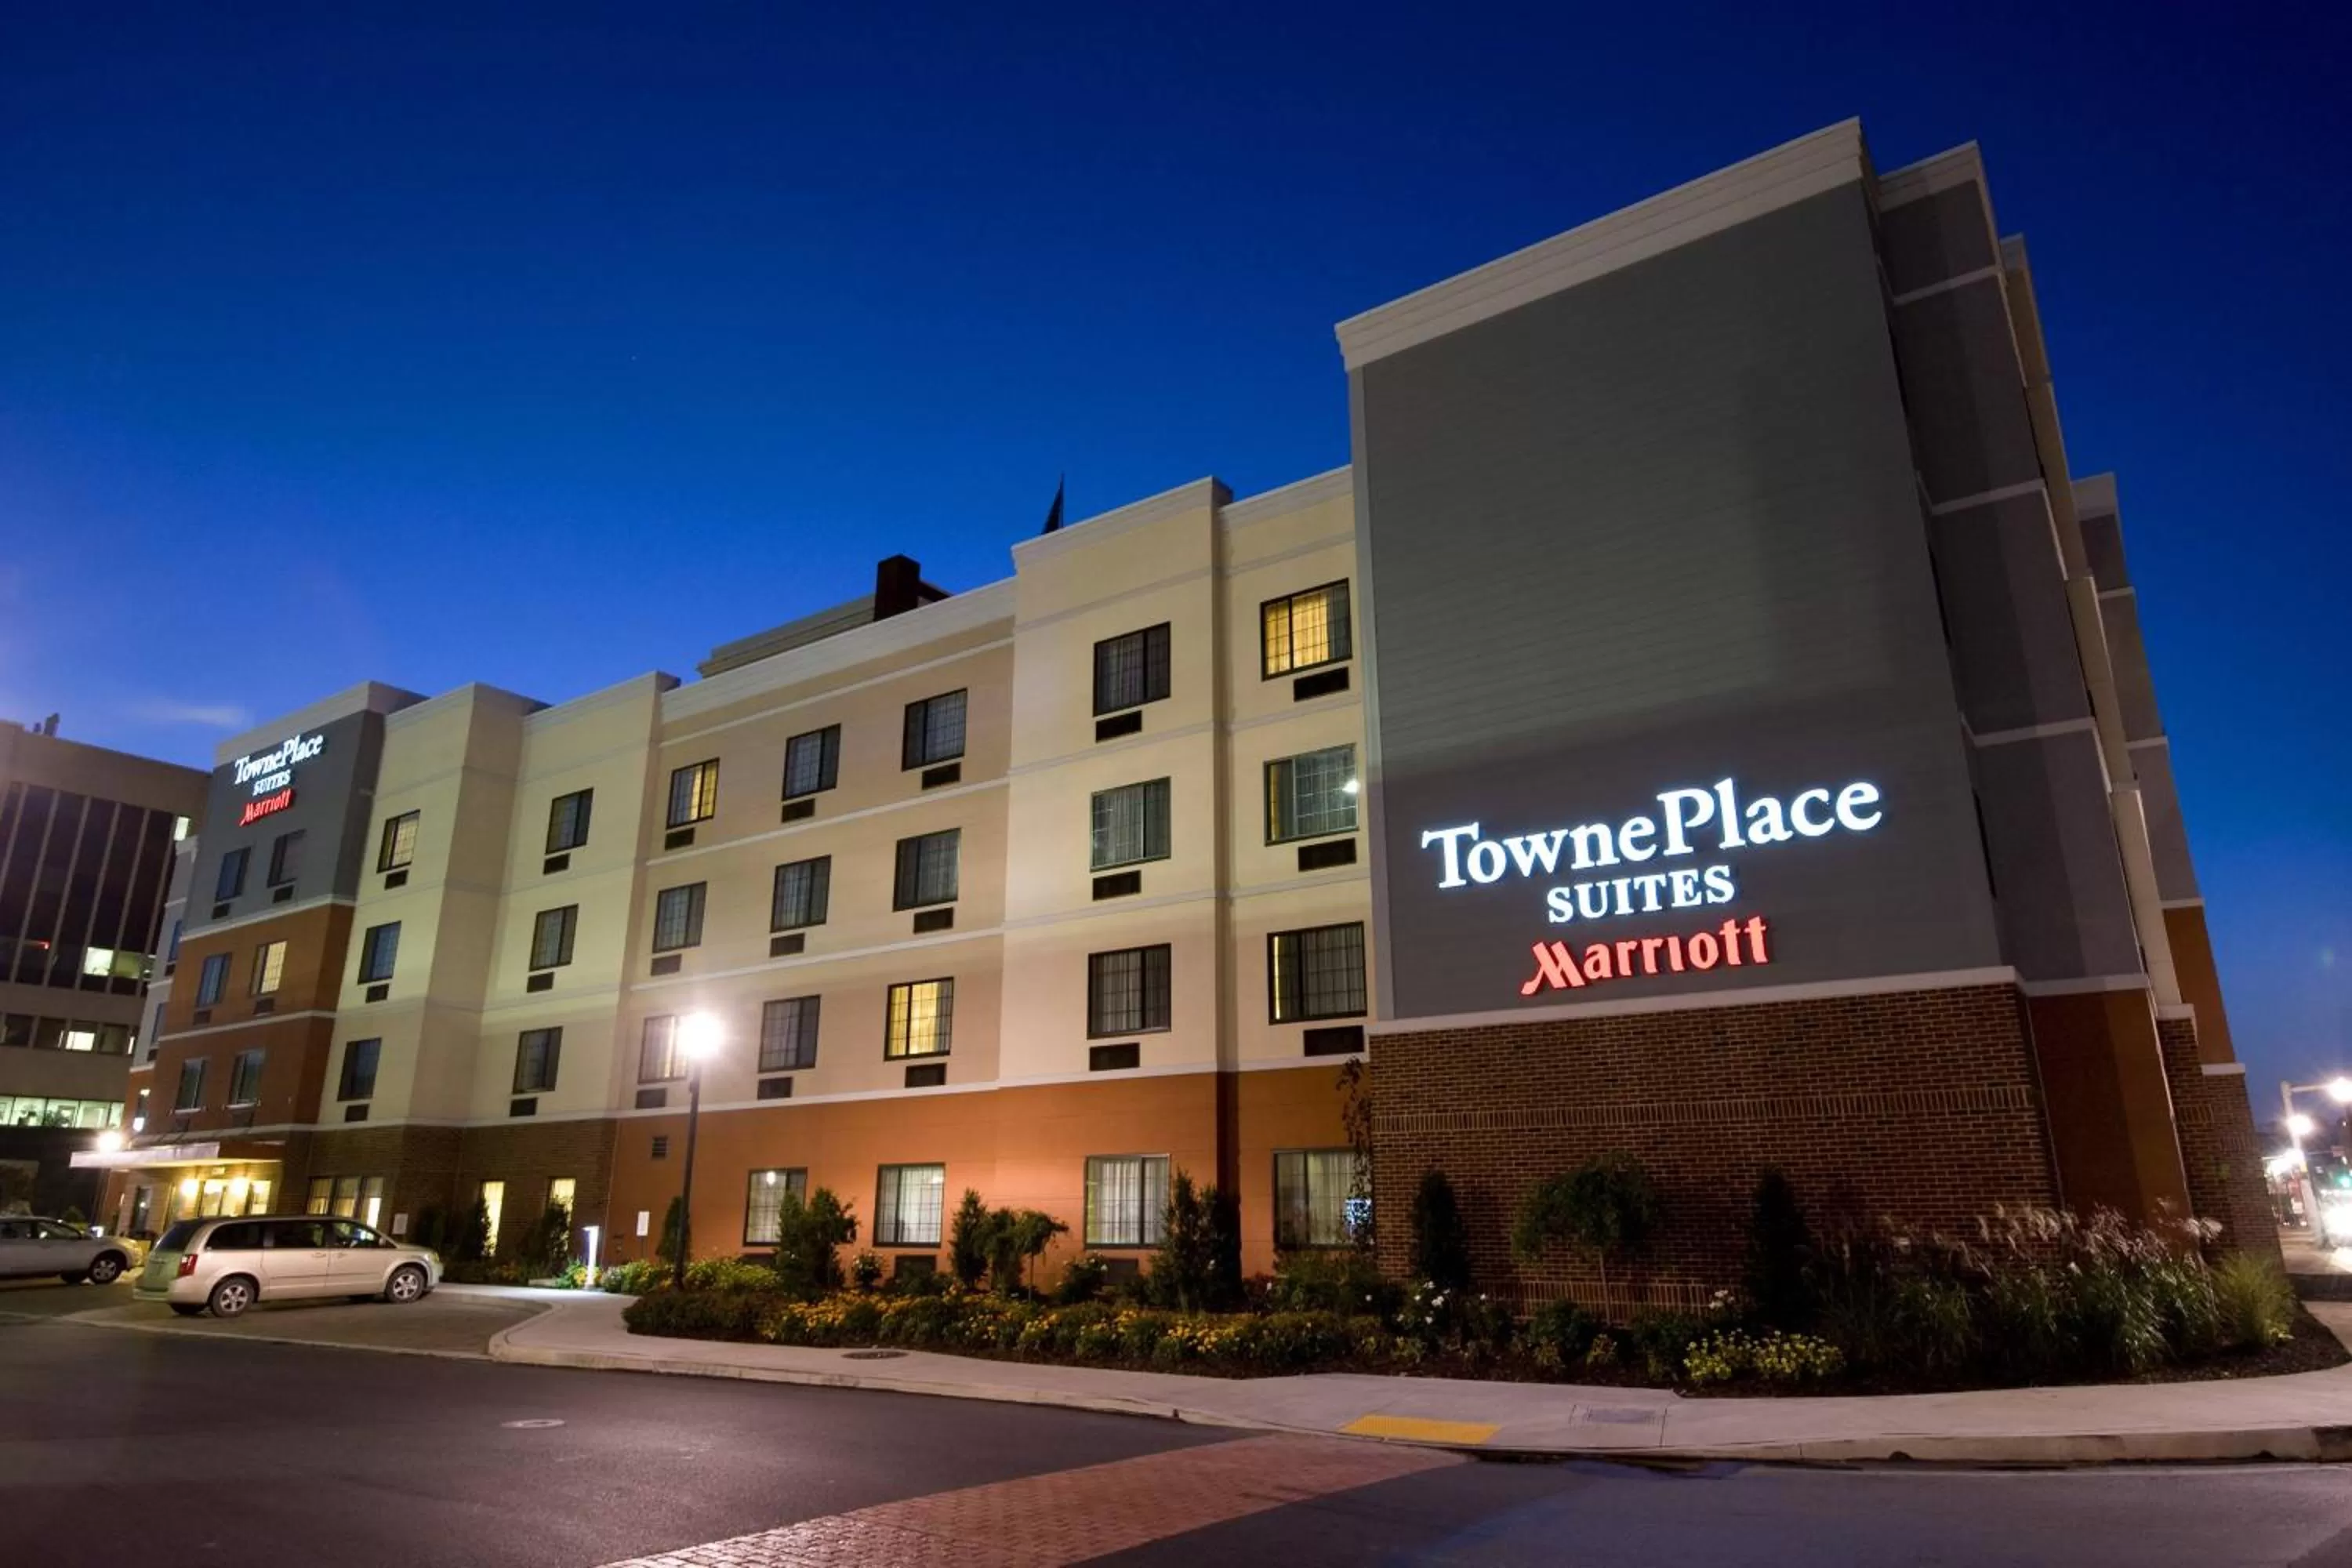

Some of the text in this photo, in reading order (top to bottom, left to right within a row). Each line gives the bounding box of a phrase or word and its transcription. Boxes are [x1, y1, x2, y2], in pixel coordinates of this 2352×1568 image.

[234, 734, 324, 785] TownePlace
[252, 769, 292, 797] SUITES
[239, 789, 292, 826] Marriott
[1421, 776, 1883, 889] TownePlace
[1546, 864, 1736, 924] SUITES
[1519, 915, 1769, 996] Marriott
